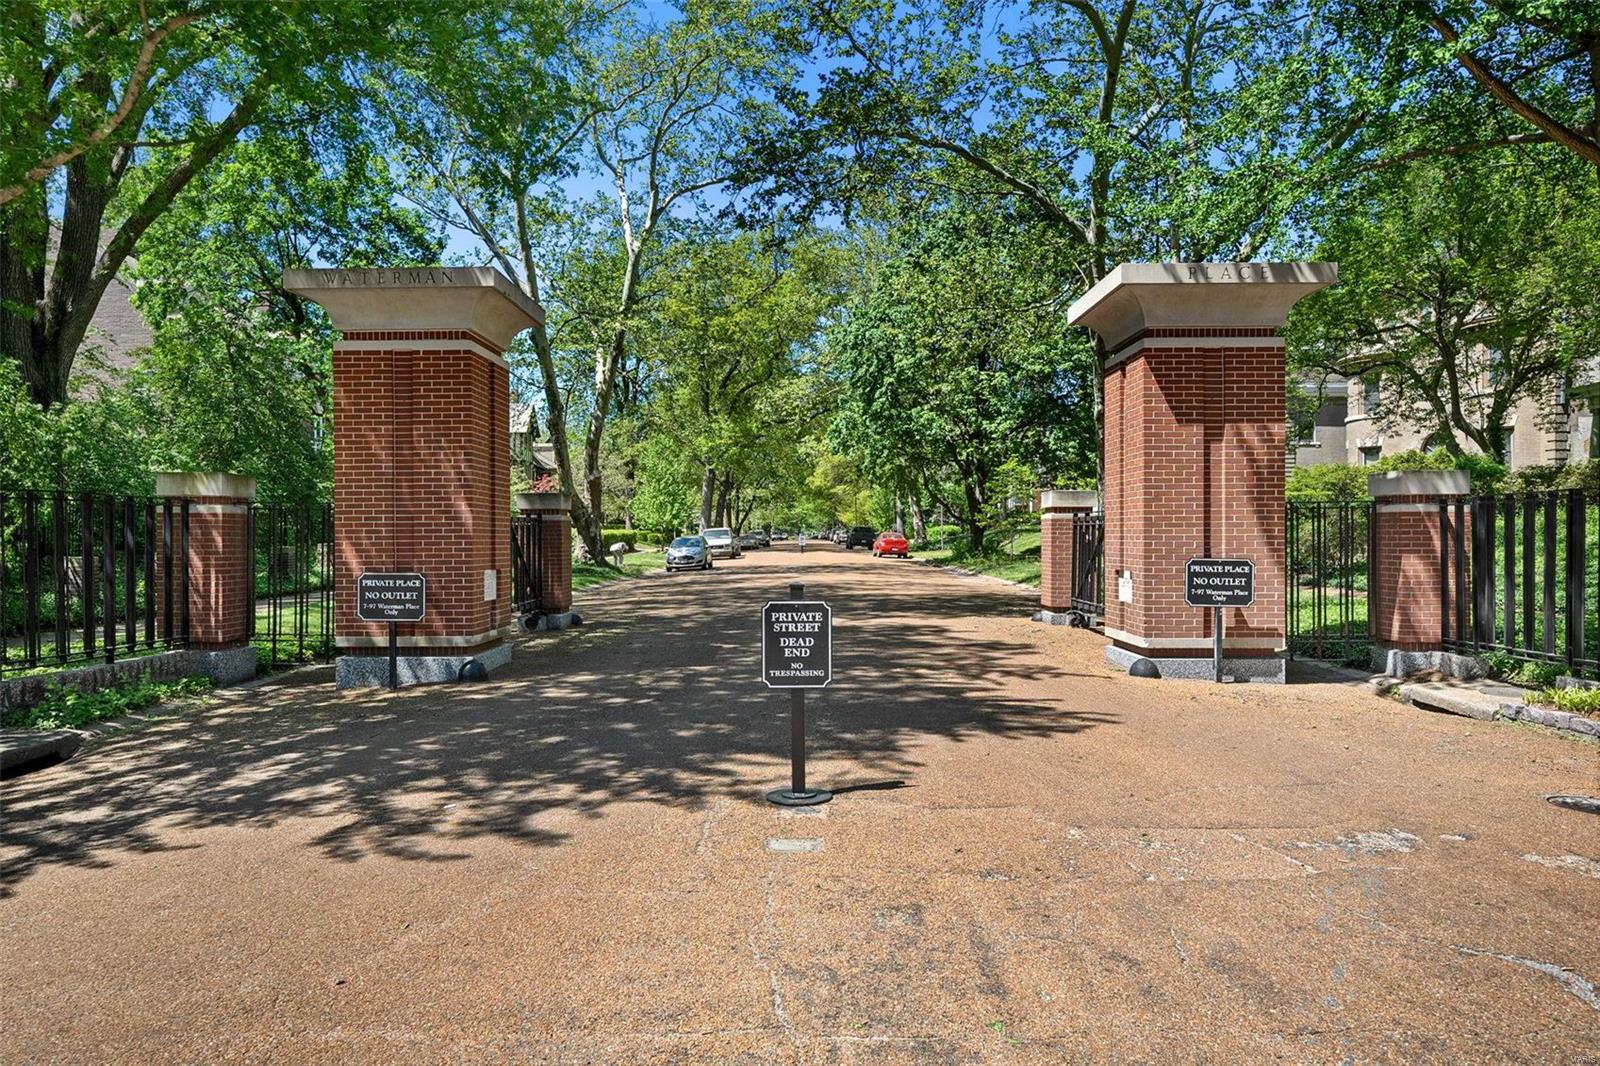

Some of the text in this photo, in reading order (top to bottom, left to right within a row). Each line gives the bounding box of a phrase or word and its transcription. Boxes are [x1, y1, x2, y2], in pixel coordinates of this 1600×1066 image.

[1187, 266, 1270, 280] PLACE
[322, 271, 454, 285] WATERMAN
[1190, 565, 1223, 573] PRIVATE
[362, 579, 421, 587] PRIVATE PLACE
[1193, 577, 1247, 586] NO OUTLET
[365, 591, 418, 600] NO OUTLET
[1212, 594, 1227, 602] Only
[405, 602, 420, 610] Place
[771, 611, 823, 621] PRIVATE
[773, 622, 821, 632] STREET
[780, 637, 815, 647] DEAD
[784, 647, 810, 657] END
[769, 669, 825, 677] TRESPASSING
